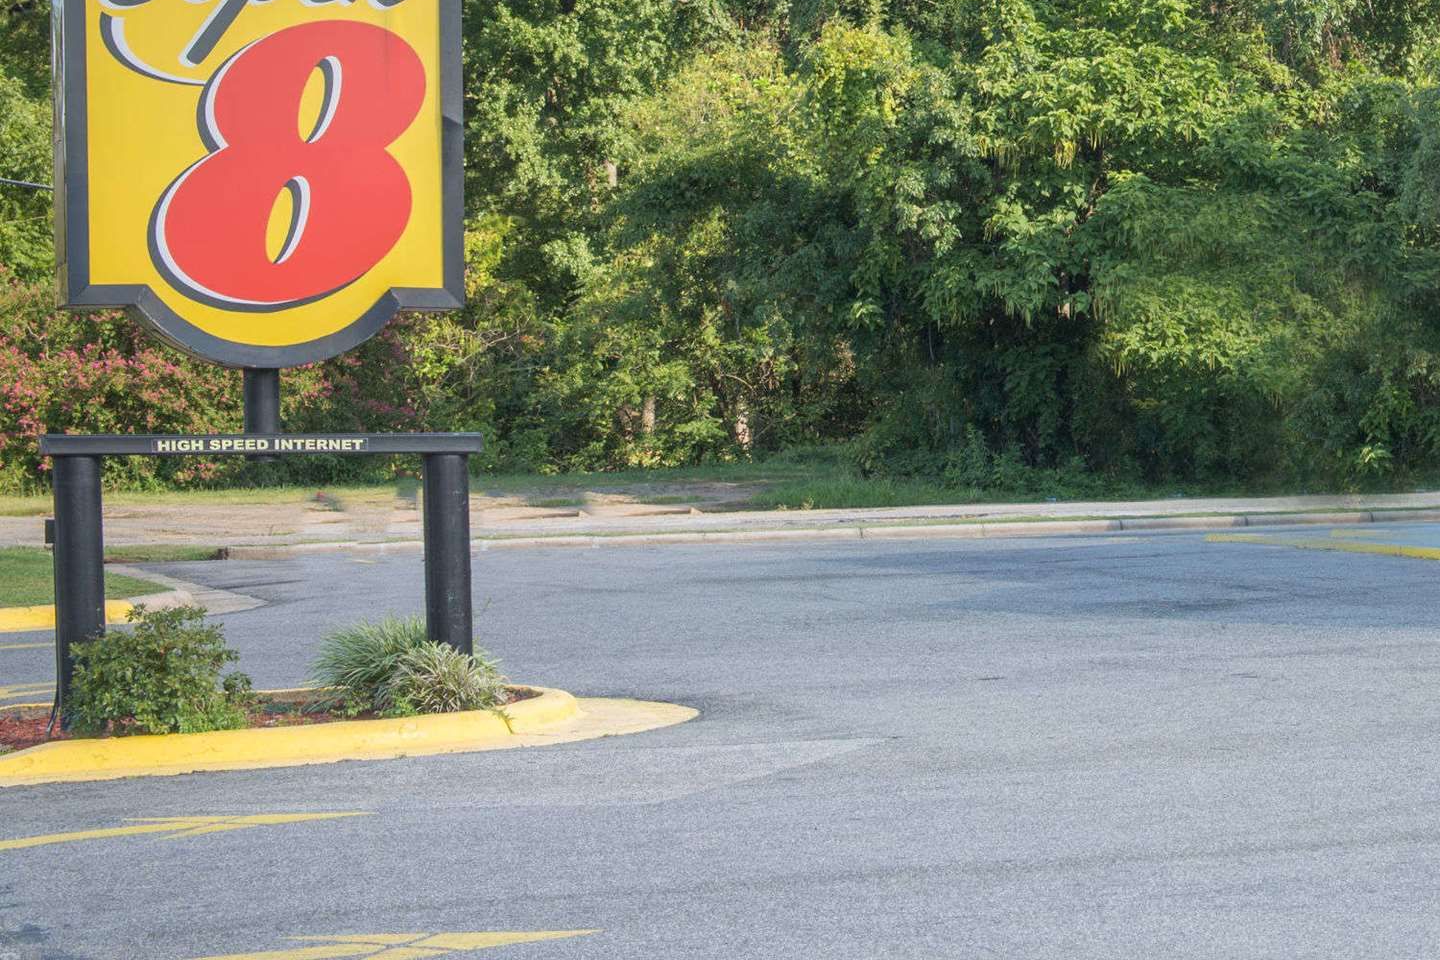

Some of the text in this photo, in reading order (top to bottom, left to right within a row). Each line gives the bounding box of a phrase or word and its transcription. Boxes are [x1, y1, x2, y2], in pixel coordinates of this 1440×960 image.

[147, 19, 427, 313] 8
[157, 438, 364, 451] HIGH SPEED INTERNET
